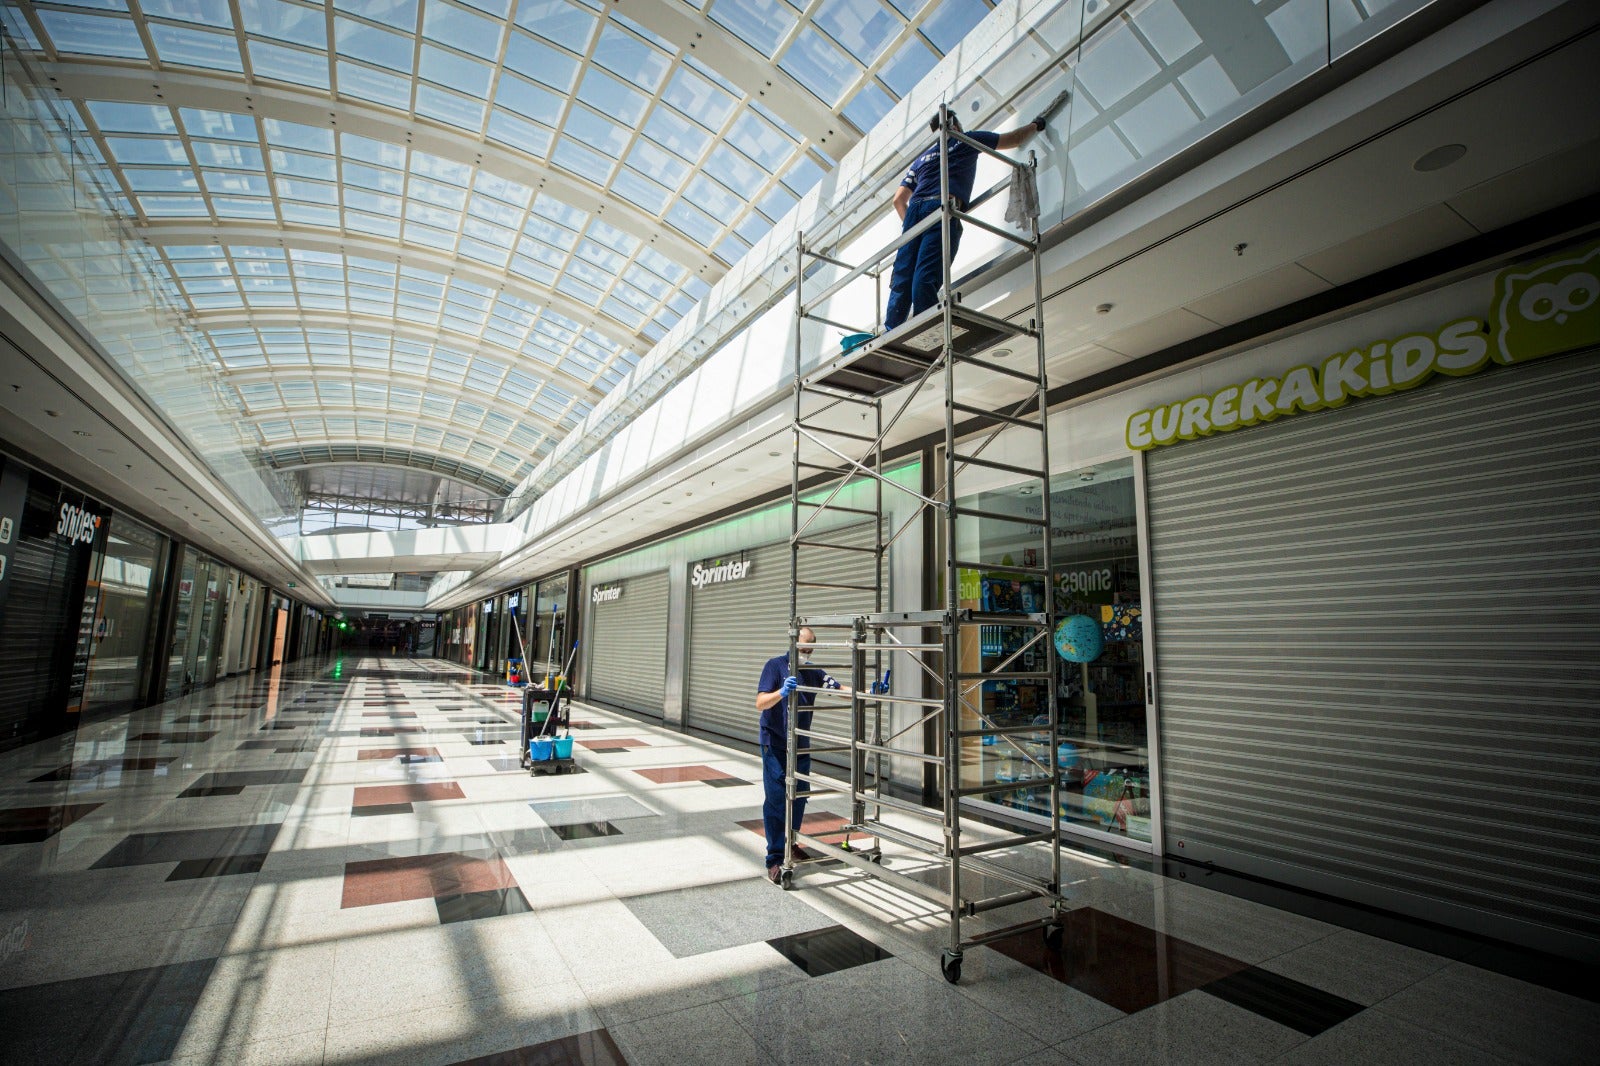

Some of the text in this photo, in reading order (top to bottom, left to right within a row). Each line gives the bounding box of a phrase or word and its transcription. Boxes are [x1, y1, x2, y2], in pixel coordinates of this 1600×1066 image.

[57, 502, 97, 546] snipes
[691, 559, 751, 589] Sprinter
[592, 585, 621, 605] Sprinter
